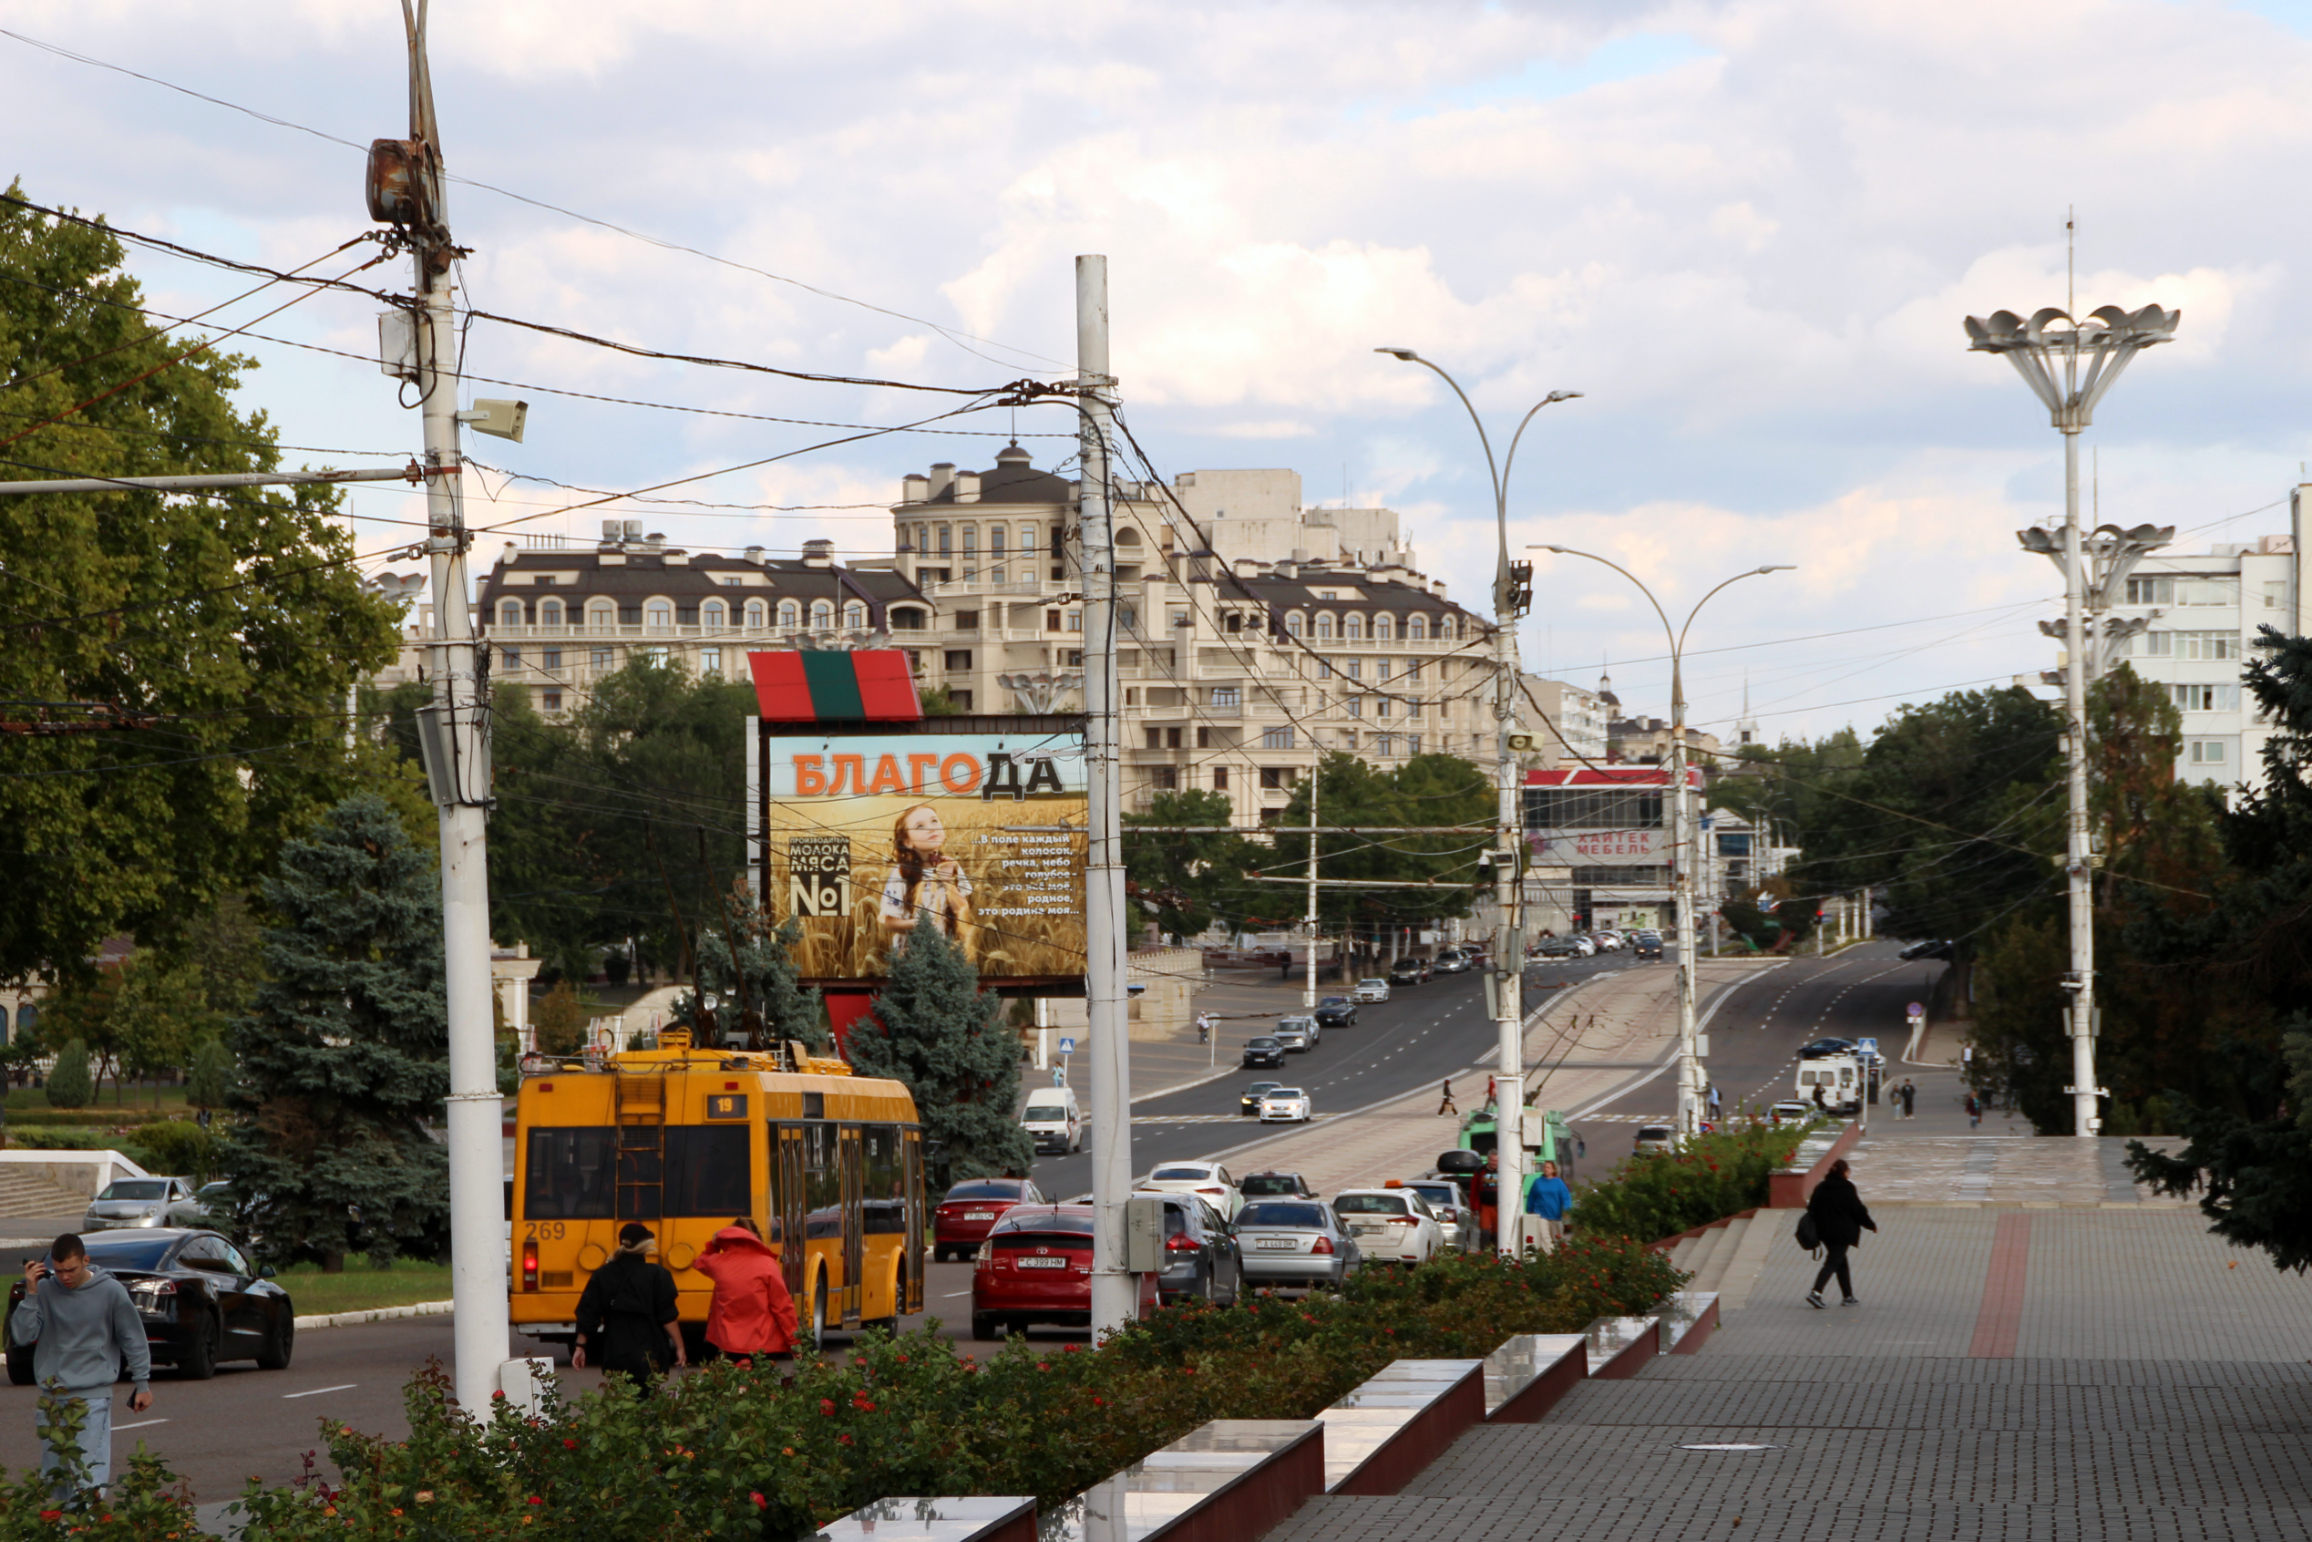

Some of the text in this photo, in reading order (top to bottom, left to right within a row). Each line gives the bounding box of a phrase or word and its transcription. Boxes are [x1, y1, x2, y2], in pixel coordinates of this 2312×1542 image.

[792, 752, 1064, 802] БЛАГОДА
[991, 835, 1019, 844] поле
[1022, 833, 1070, 844] каждый
[1578, 832, 1650, 843] ХАЙТЕК
[790, 844, 849, 856] МОЛОКА
[1021, 847, 1073, 856] колосок,
[1577, 844, 1650, 855] МЕБЕЛЬ
[790, 856, 850, 872] МЯСА
[1002, 857, 1070, 869] речка, небо
[1025, 869, 1070, 881] голубое
[1027, 895, 1073, 905] родное,
[978, 908, 998, 916] это
[1002, 907, 1045, 917] родина
[717, 1097, 732, 1113] 19
[525, 1221, 566, 1241] 269
[1035, 1258, 1049, 1266] 399
[1051, 1258, 1063, 1266] HM
